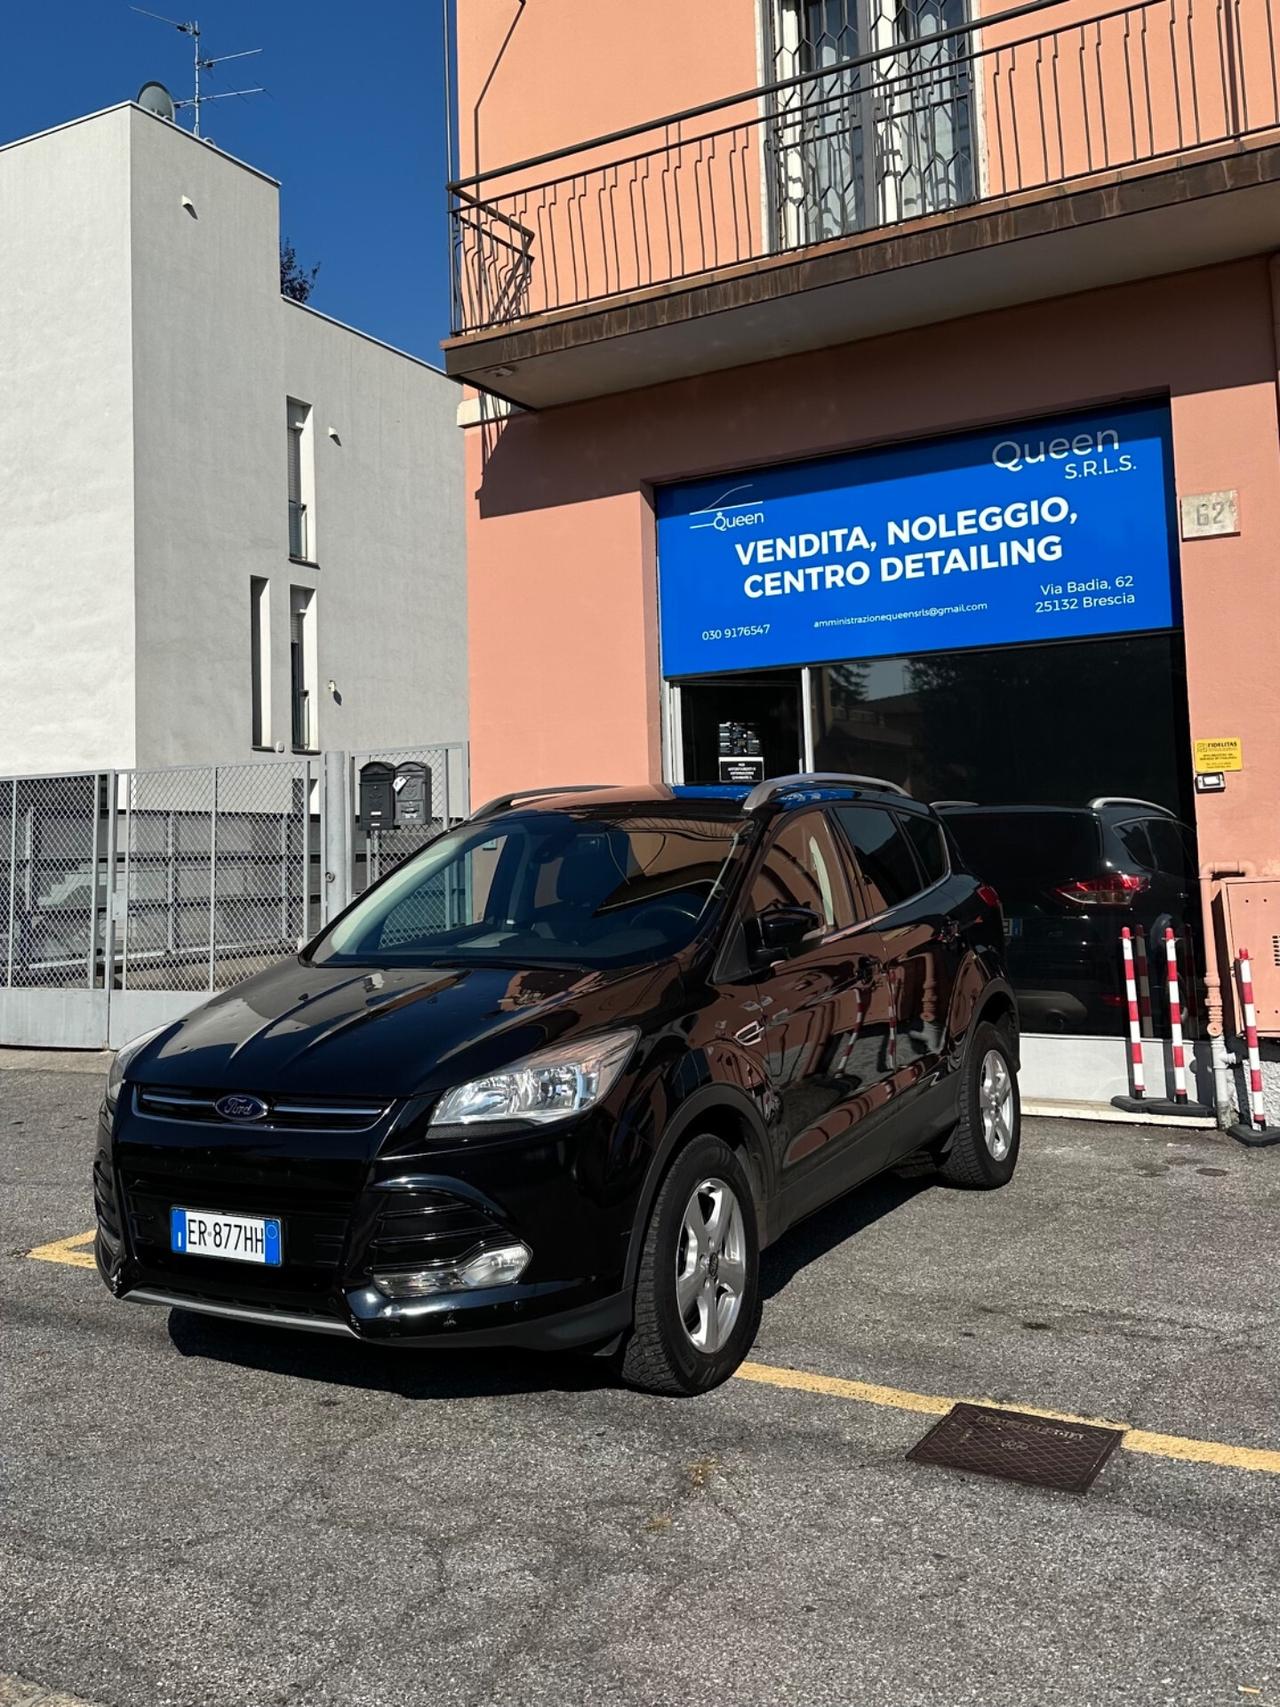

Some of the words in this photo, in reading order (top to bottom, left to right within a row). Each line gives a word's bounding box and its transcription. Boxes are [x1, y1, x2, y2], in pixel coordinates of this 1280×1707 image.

[992, 429, 1119, 472] Queen
[1064, 455, 1137, 480] S.R.L.S.
[713, 511, 764, 532] Queen
[735, 526, 877, 566] VENDITA,
[887, 496, 1078, 546] NOLEGGIO,
[744, 561, 870, 598] CENTRO
[880, 535, 1062, 582] DETAILING
[1040, 583, 1063, 596] Via
[1067, 578, 1112, 593] Badia,
[1115, 575, 1134, 588] 62
[1035, 598, 1079, 613] 25132
[1083, 592, 1135, 608] Brescia
[814, 602, 988, 628] amministrazionequeensrls@gmail.com
[702, 629, 722, 641] 030
[724, 624, 771, 639] 9176547
[224, 1097, 252, 1116] Ford
